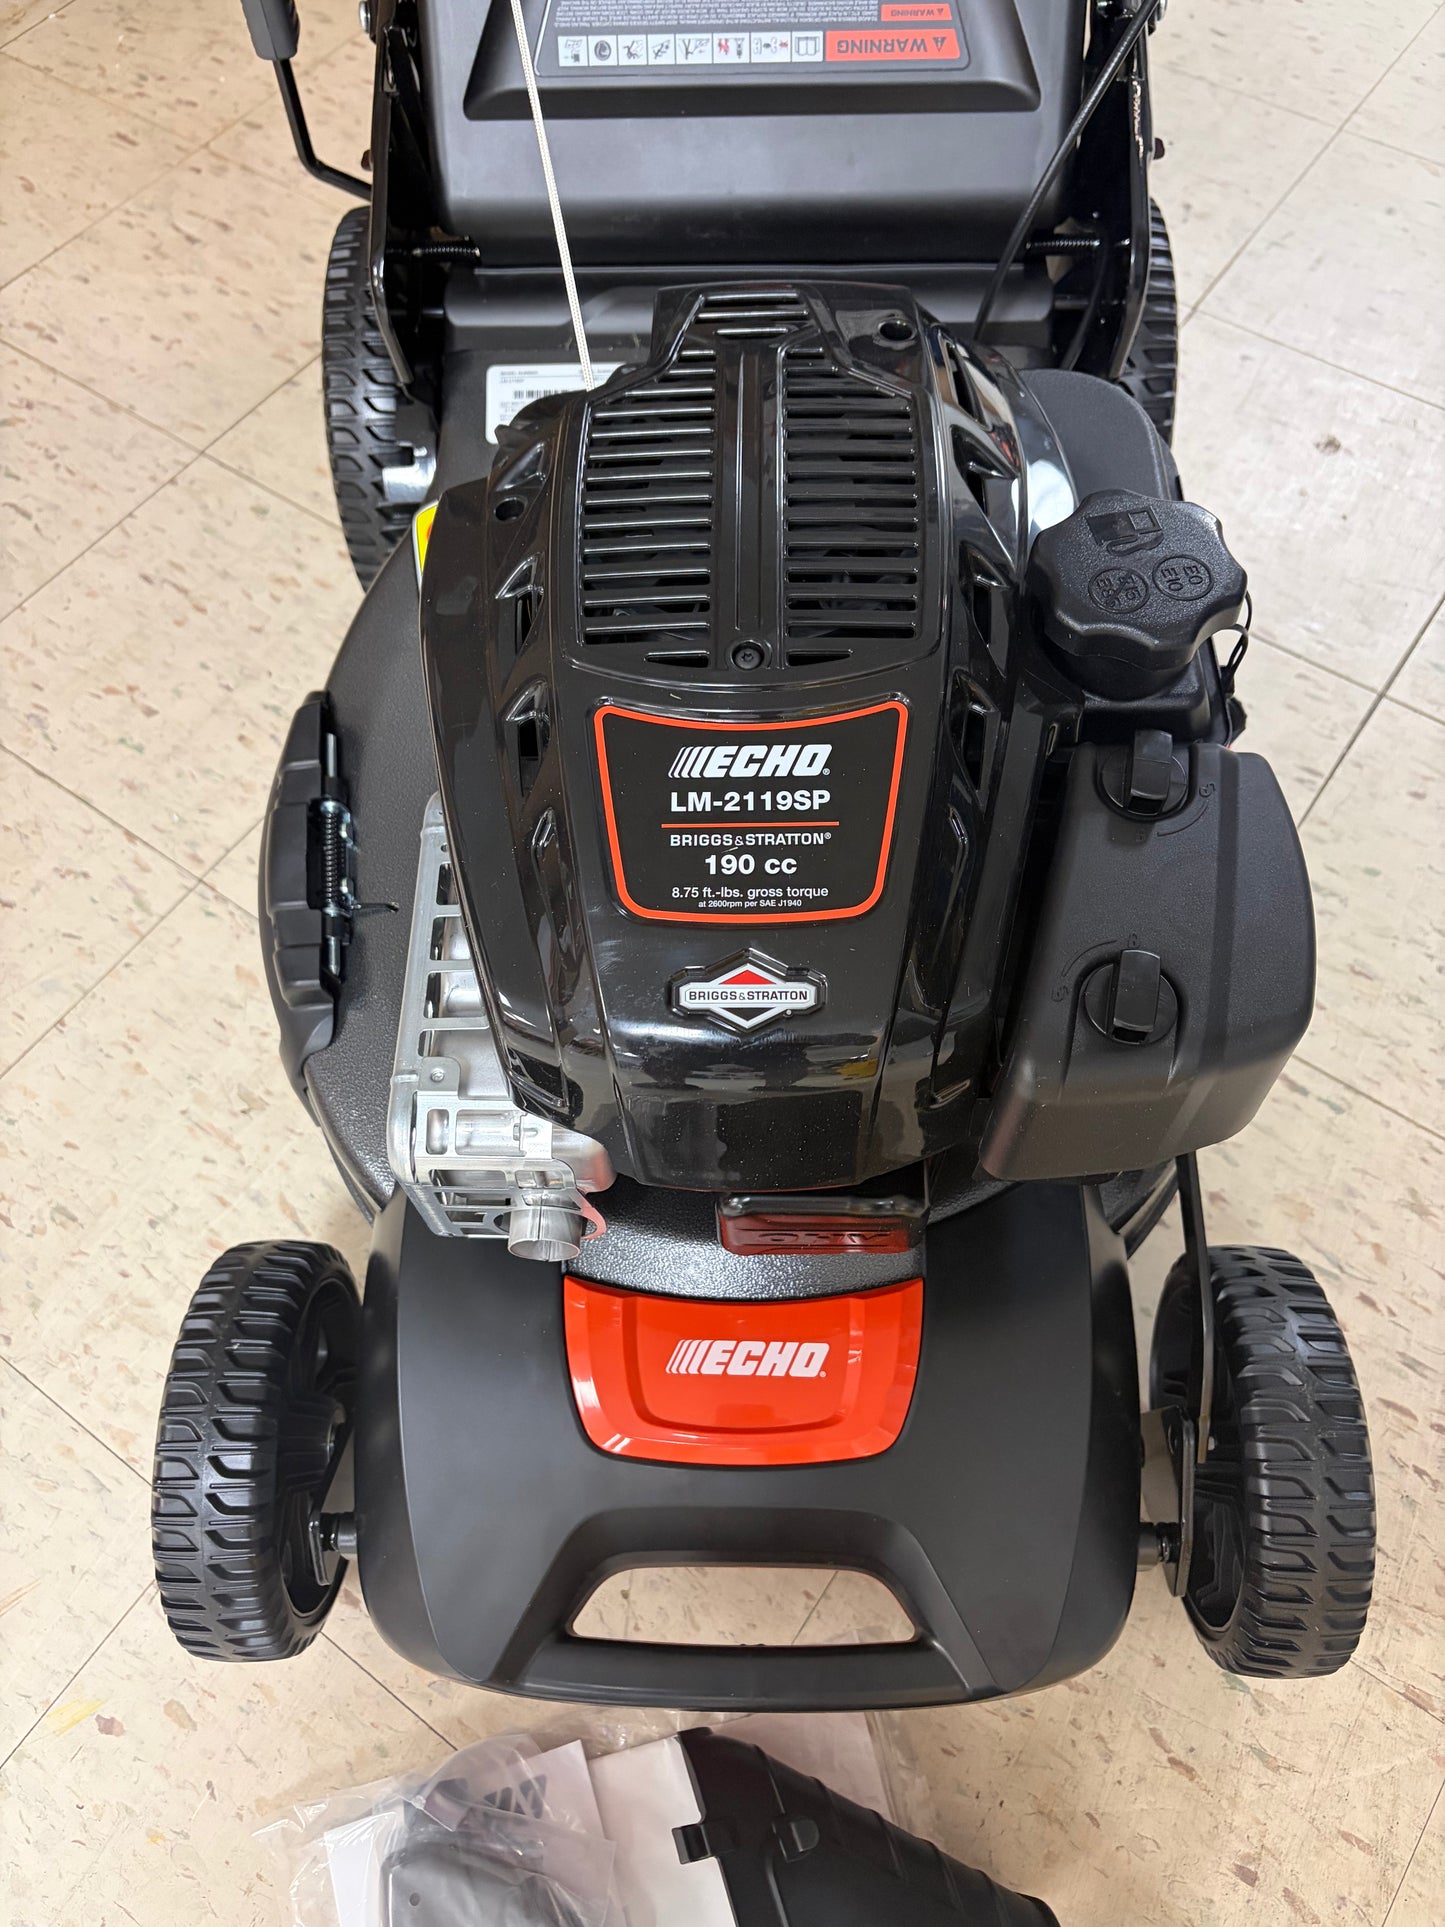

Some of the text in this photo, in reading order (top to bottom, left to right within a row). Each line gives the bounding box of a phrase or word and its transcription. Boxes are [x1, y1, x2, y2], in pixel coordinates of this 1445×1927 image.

[891, 8, 935, 17] WARNING
[837, 38, 928, 54] WARNING
[670, 789, 831, 812] LM-2119SP
[705, 854, 798, 875] 190 cc
[671, 886, 829, 900] 8.75 ft.-lbs. gross torque
[708, 900, 743, 909] 2600rpm
[744, 901, 757, 909] per
[759, 899, 776, 907] SAE
[778, 899, 802, 907] J1940
